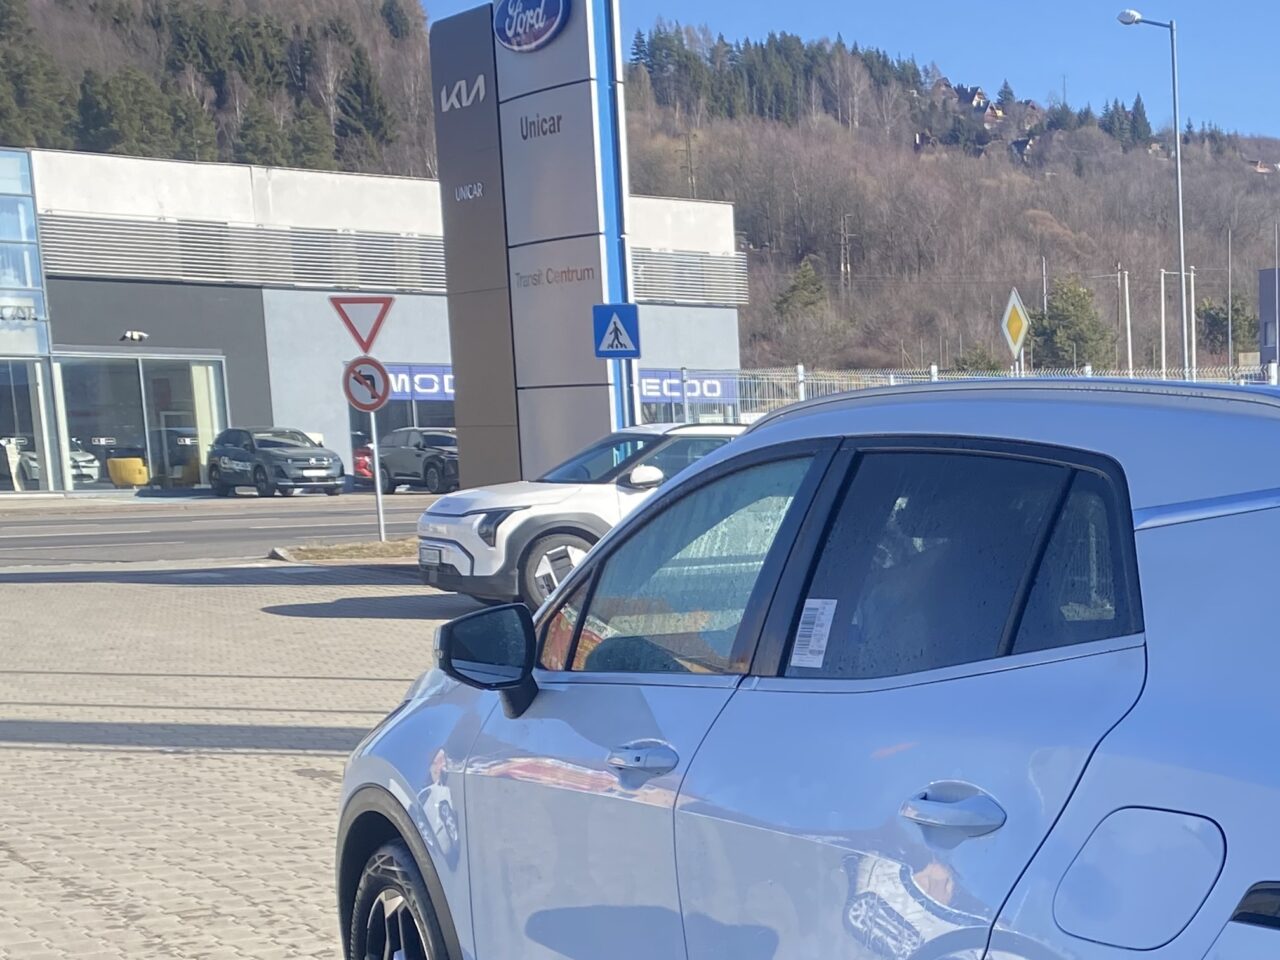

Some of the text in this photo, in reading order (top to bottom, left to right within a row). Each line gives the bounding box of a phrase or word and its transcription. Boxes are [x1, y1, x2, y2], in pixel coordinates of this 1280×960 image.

[505, 0, 547, 38] Ford
[440, 74, 486, 113] KIA
[520, 113, 562, 141] Unicar
[455, 182, 484, 202] UNICAR
[546, 265, 595, 285] Centrum
